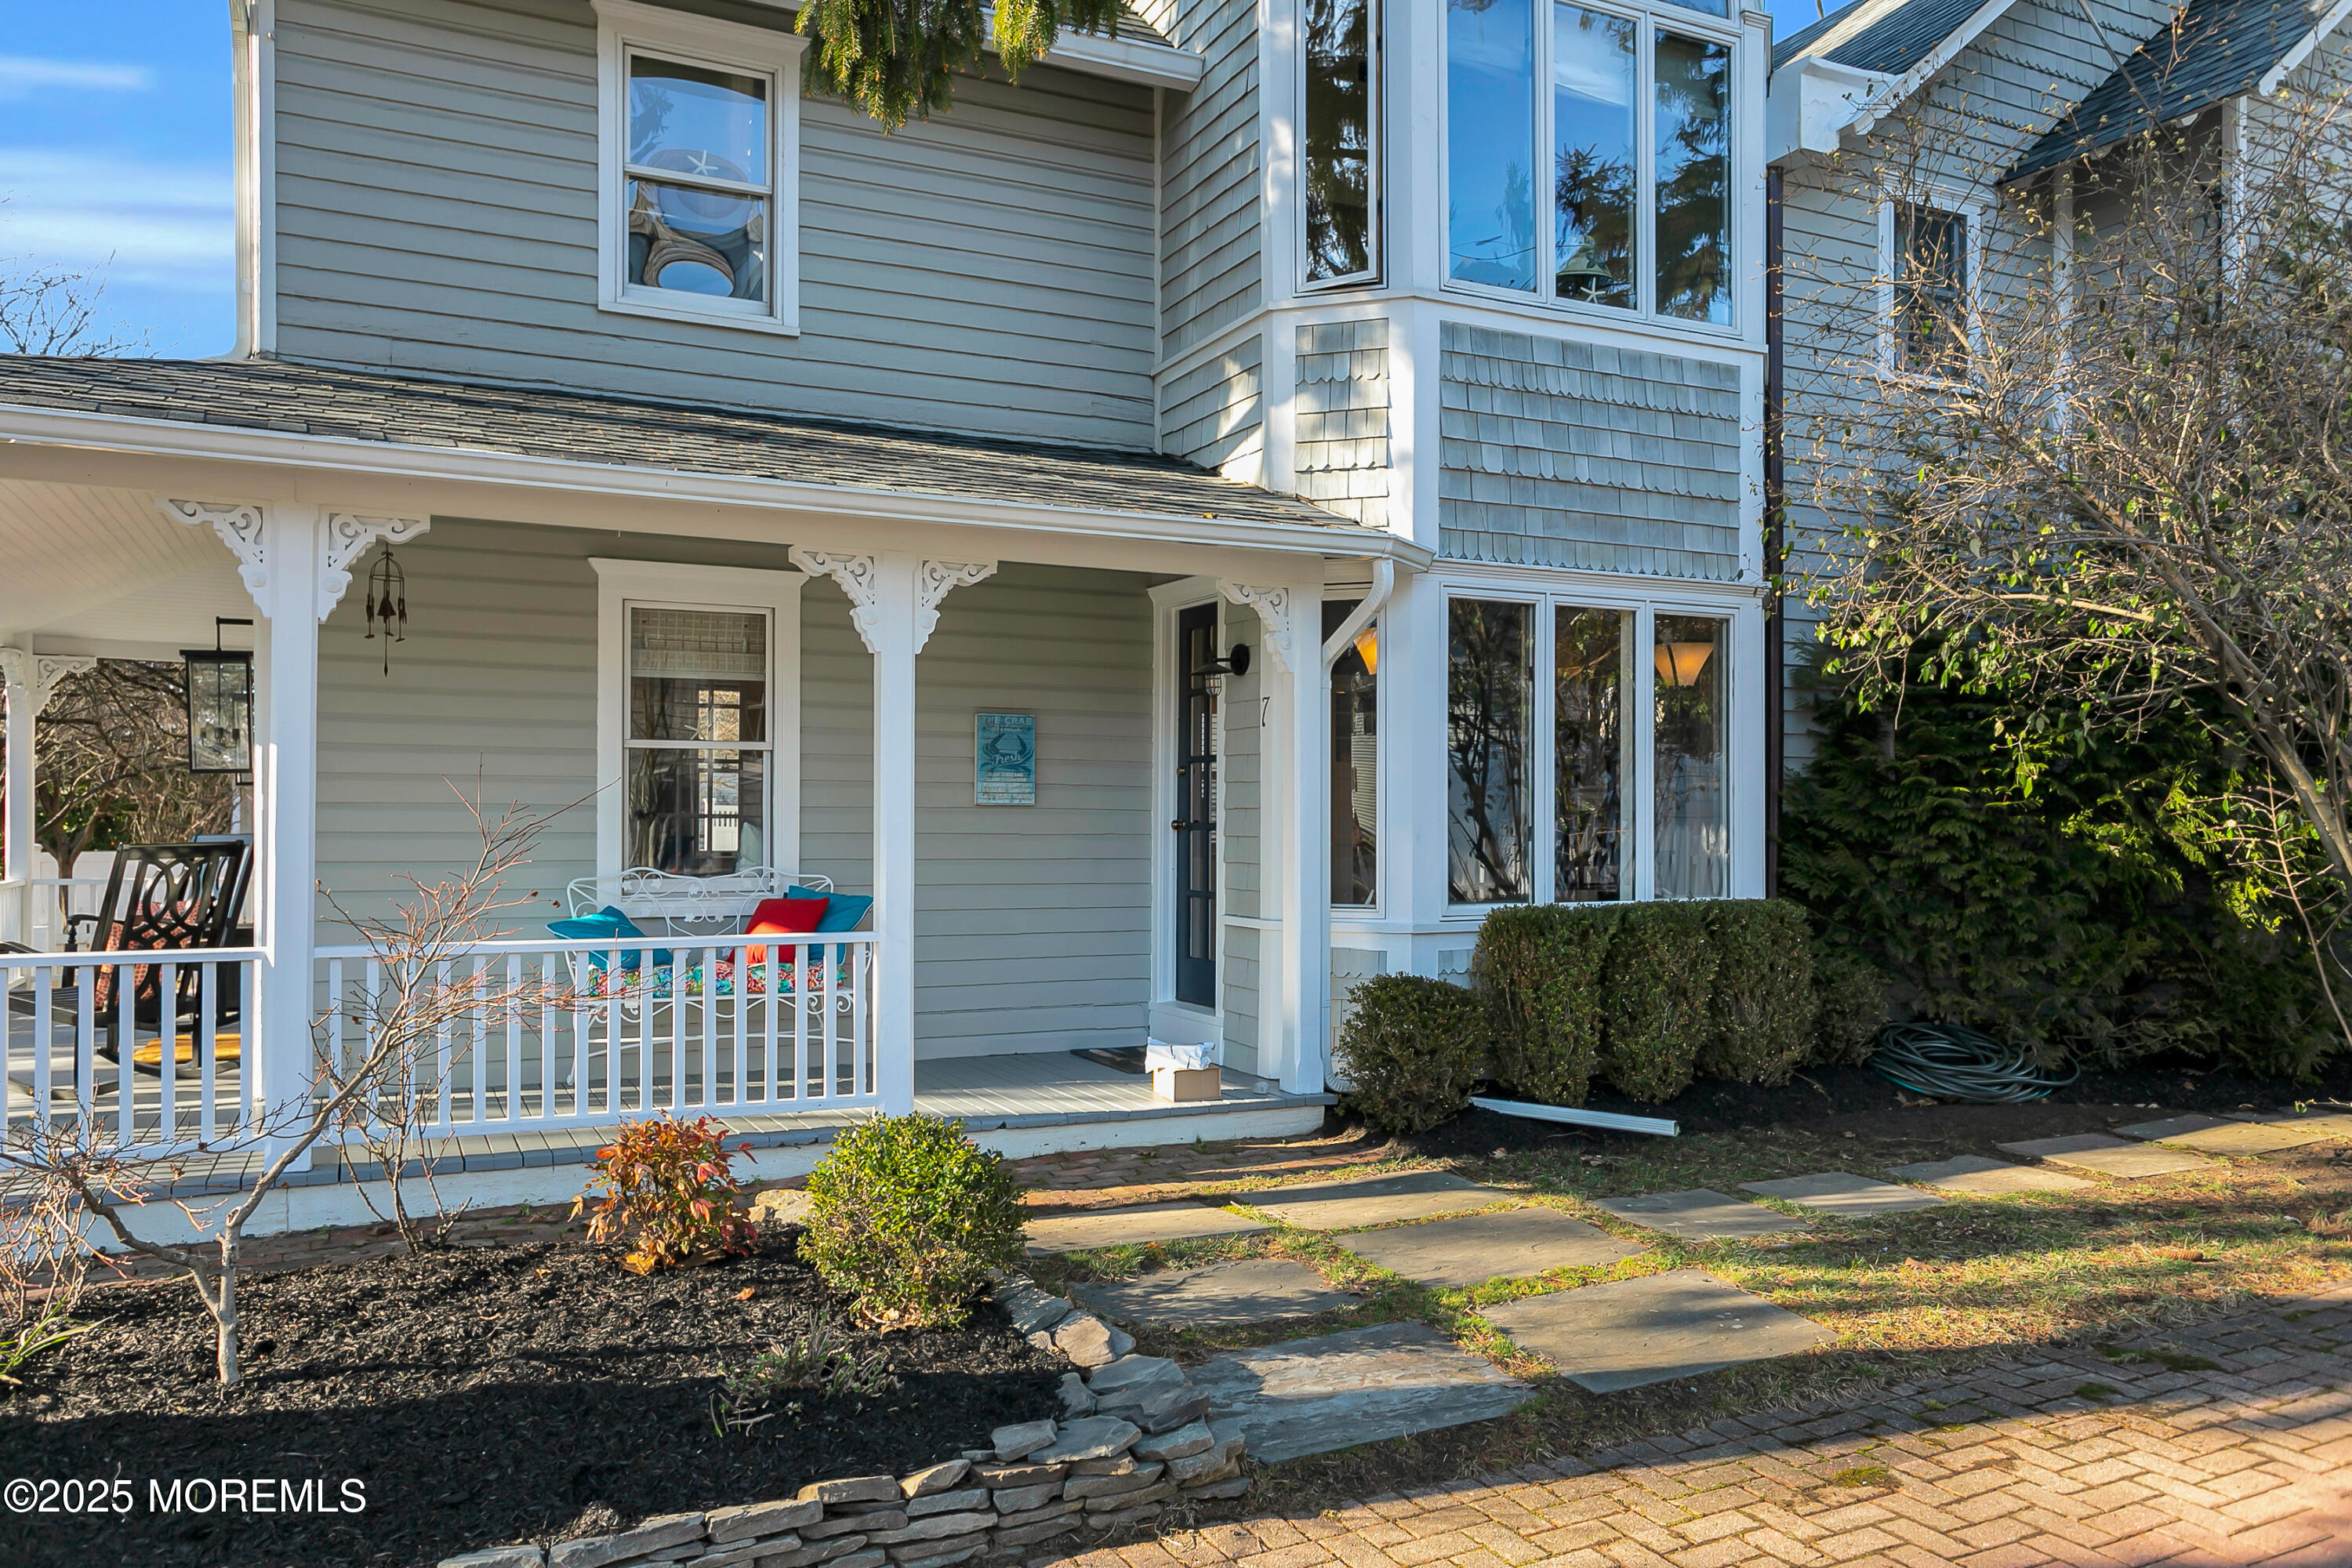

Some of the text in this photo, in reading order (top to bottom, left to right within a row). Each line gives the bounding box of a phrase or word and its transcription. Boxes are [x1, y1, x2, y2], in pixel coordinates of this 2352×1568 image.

[1261, 695, 1270, 728] 7
[982, 716, 1033, 725] THE CRAB
[991, 751, 1021, 766] Fresh
